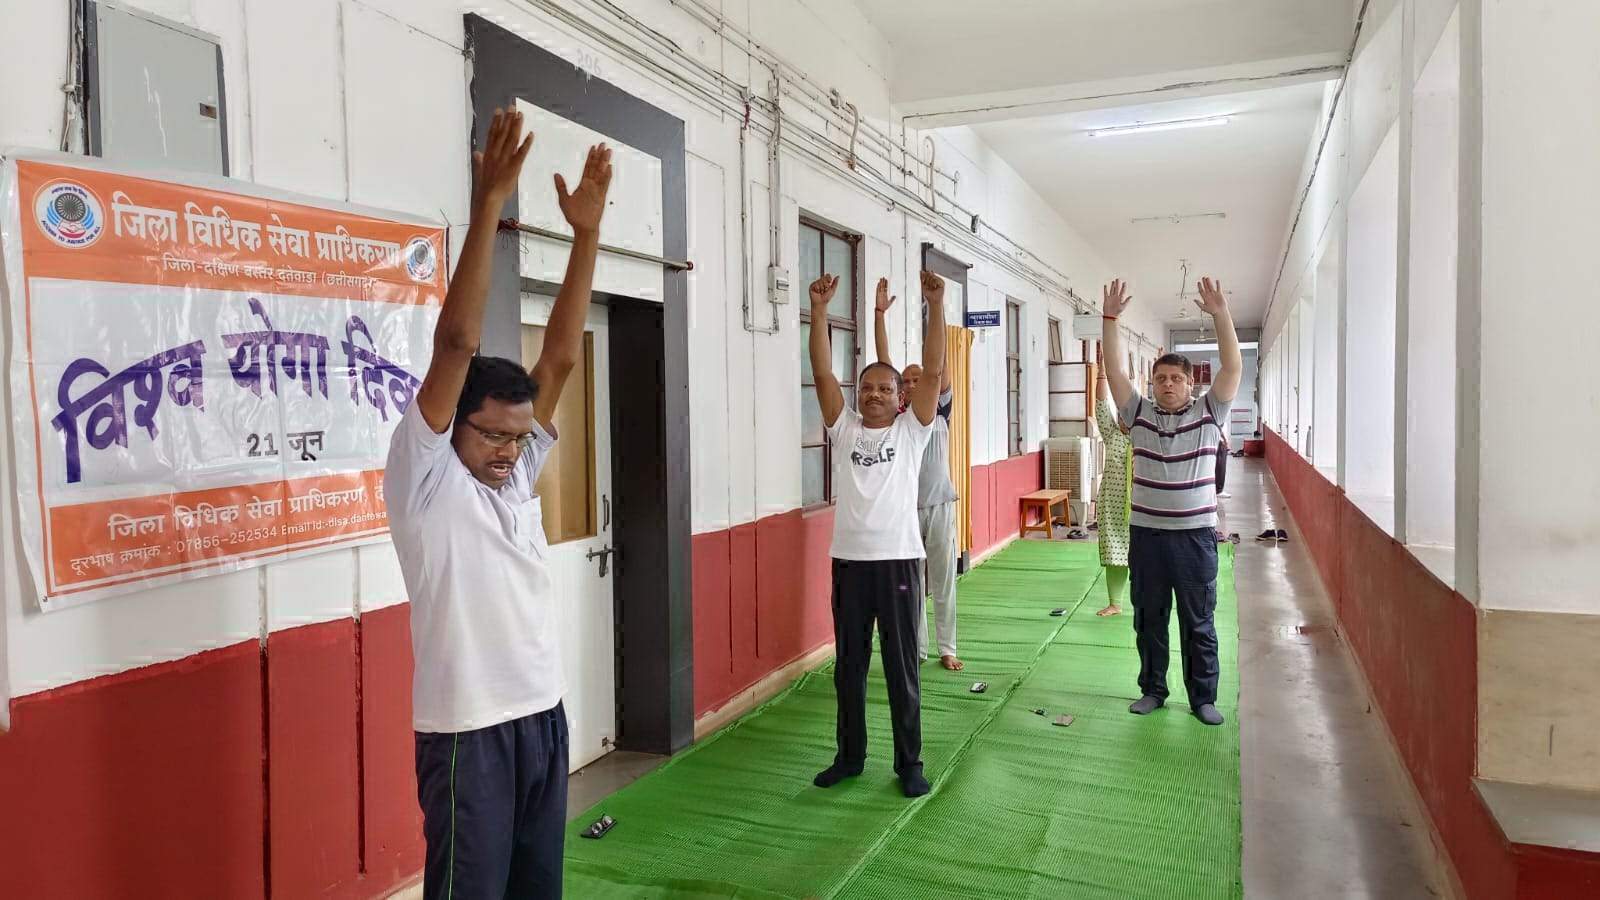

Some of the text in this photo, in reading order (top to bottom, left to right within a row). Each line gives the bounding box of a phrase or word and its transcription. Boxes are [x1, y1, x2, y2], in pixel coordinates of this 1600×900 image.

[112, 190, 400, 267] जिला विधिक सेवा प्राधिकरण
[51, 298, 423, 483] विश्व योगा दिव
[247, 431, 325, 461] 21 जून
[108, 514, 165, 541] जिला
[174, 502, 240, 531] विधिक
[246, 496, 283, 519] सेवा
[176, 526, 277, 553] 07856-252534
[281, 522, 310, 537] Email
